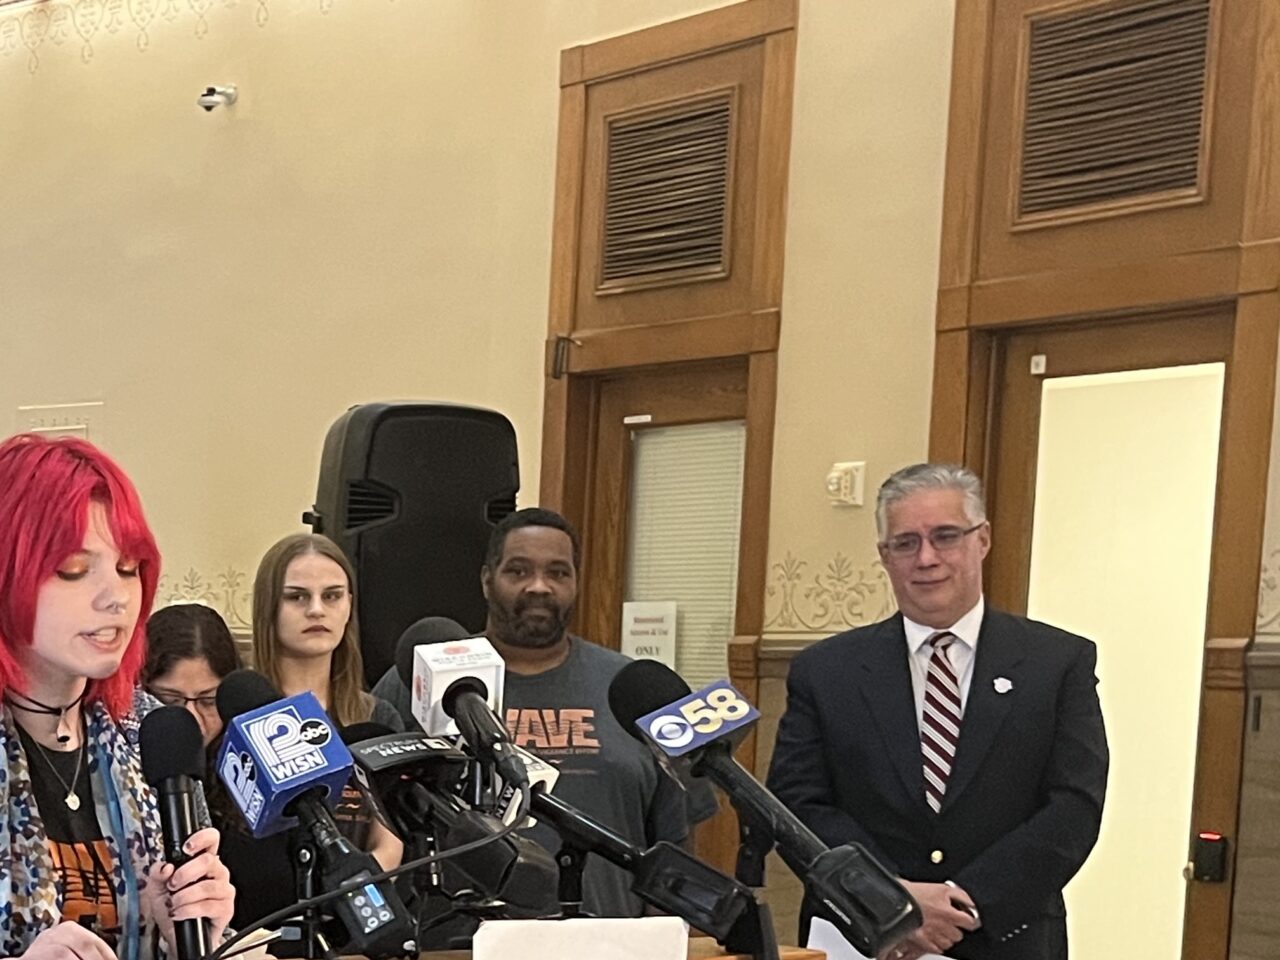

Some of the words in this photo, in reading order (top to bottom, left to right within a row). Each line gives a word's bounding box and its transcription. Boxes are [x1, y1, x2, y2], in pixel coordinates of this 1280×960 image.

[679, 688, 750, 733] 58
[300, 724, 328, 741] abc
[270, 750, 324, 780] WISN
